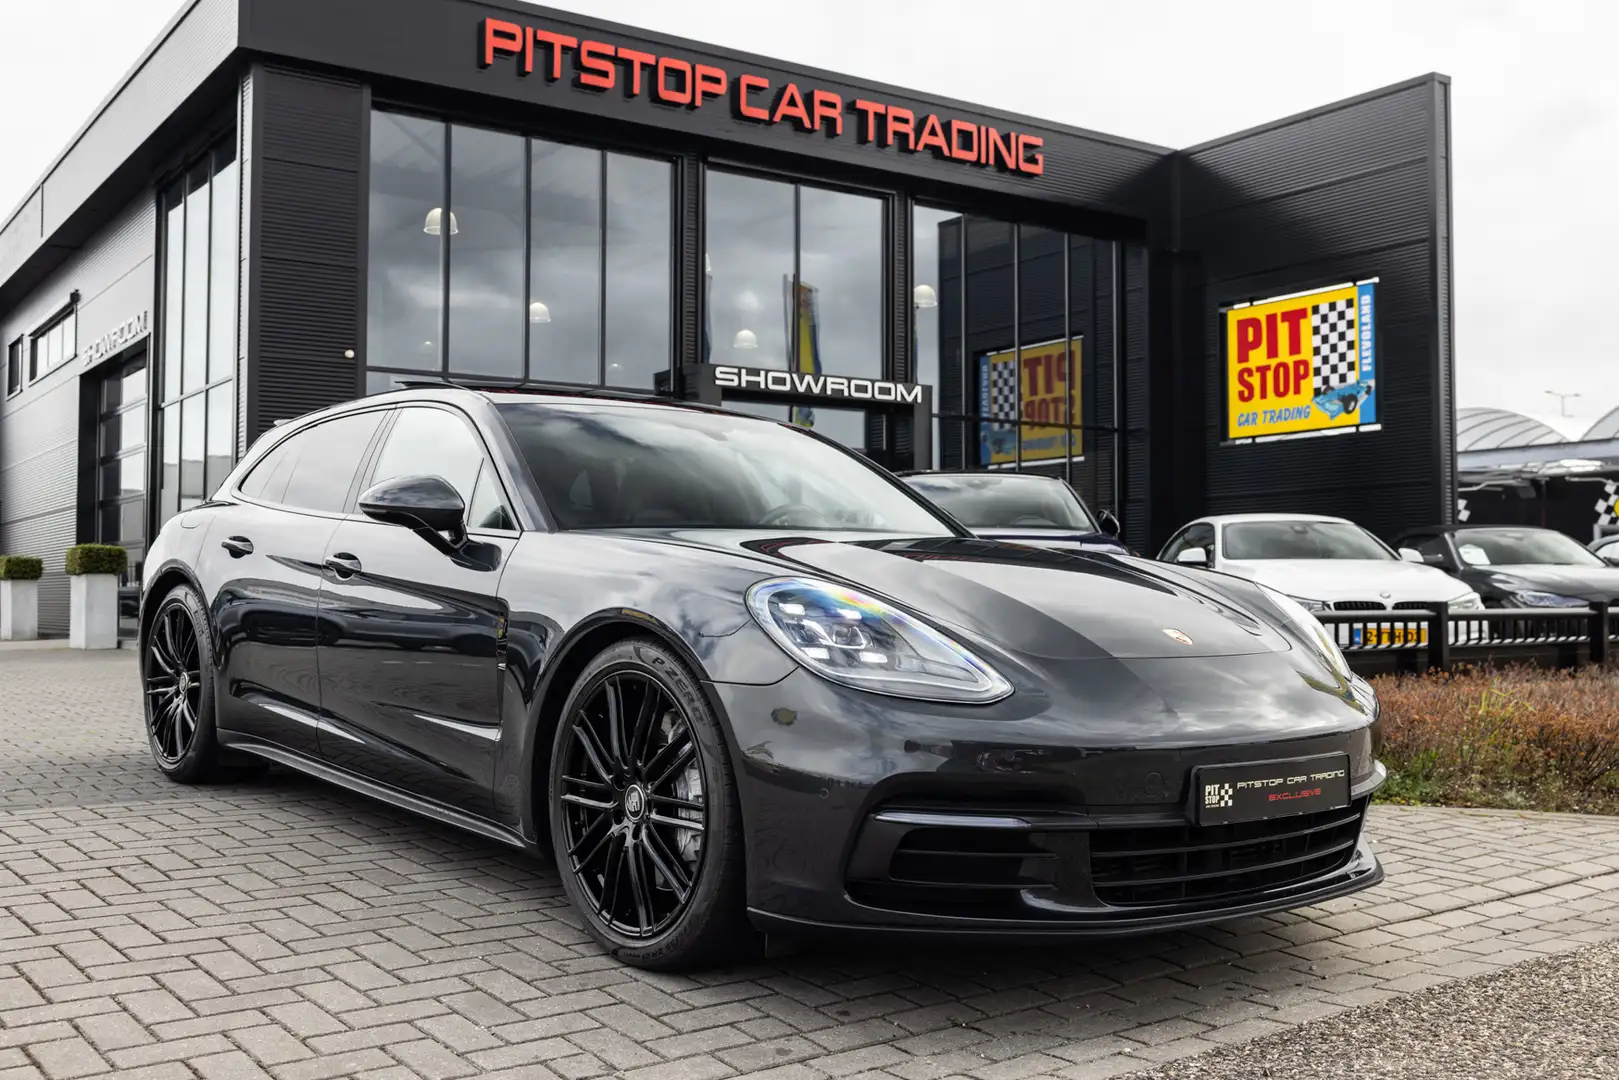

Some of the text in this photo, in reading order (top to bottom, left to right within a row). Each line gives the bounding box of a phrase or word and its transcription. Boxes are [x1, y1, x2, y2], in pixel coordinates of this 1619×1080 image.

[484, 17, 1044, 175] PITSTOP CAR TRADING
[1236, 307, 1308, 364] PIT
[1360, 294, 1373, 372] FLEVOLAND
[714, 366, 923, 403] SHOWROOM
[1236, 359, 1310, 403] STOP
[1237, 405, 1312, 427] CAR TRADING
[1204, 783, 1220, 796] PIT
[1237, 769, 1346, 790] PITSTOP CAR TRADING
[1204, 794, 1220, 805] STOP
[1268, 787, 1321, 802] EXCLUSIVE
